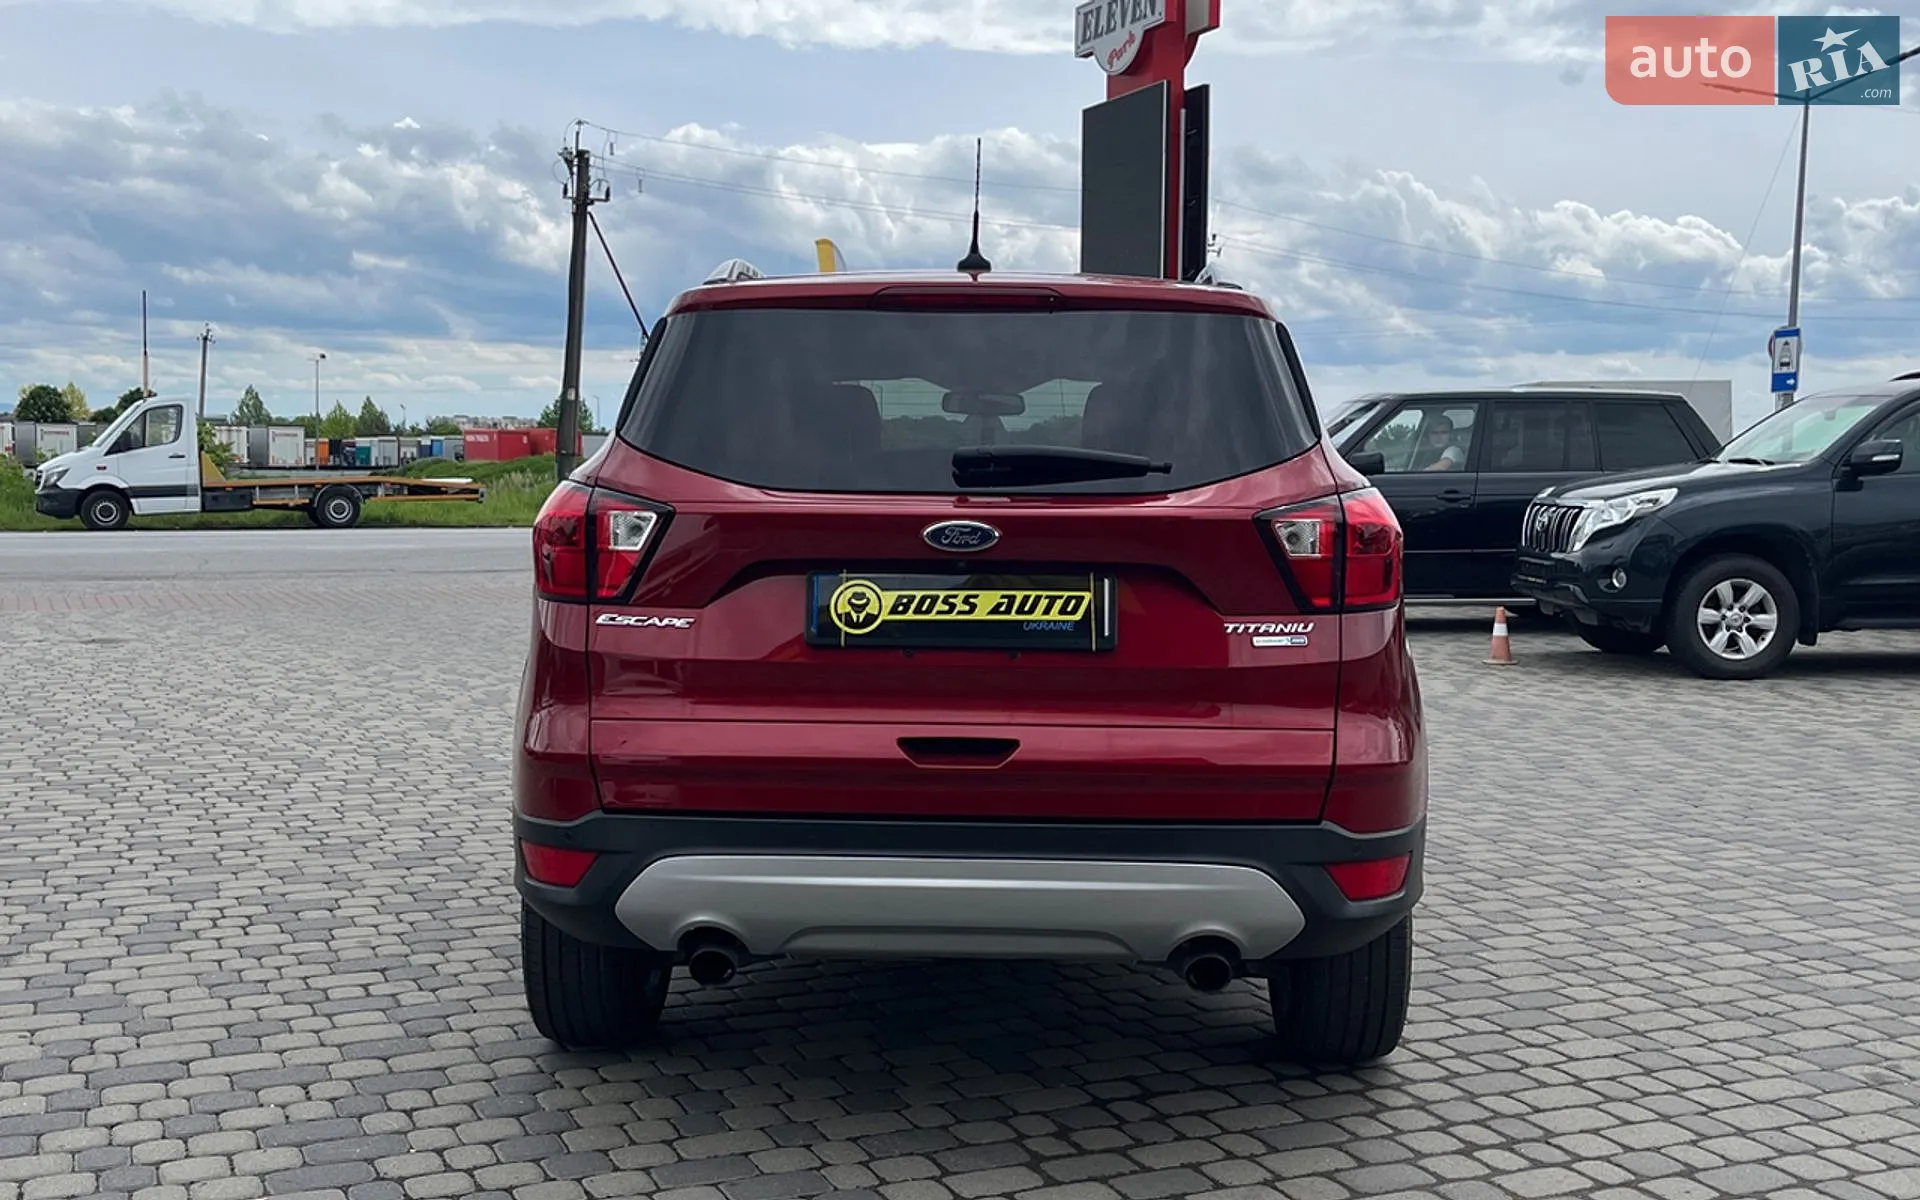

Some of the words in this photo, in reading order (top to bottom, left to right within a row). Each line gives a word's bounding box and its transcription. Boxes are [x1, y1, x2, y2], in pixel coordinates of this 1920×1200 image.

[1081, 0, 1157, 44] ELEVEN
[941, 526, 982, 544] Ford
[888, 595, 979, 615] BOSS
[988, 595, 1086, 615] AUTO
[595, 614, 695, 628] ESCAPE
[1023, 621, 1075, 631] UKRAINE
[1224, 623, 1314, 633] TITANIU
